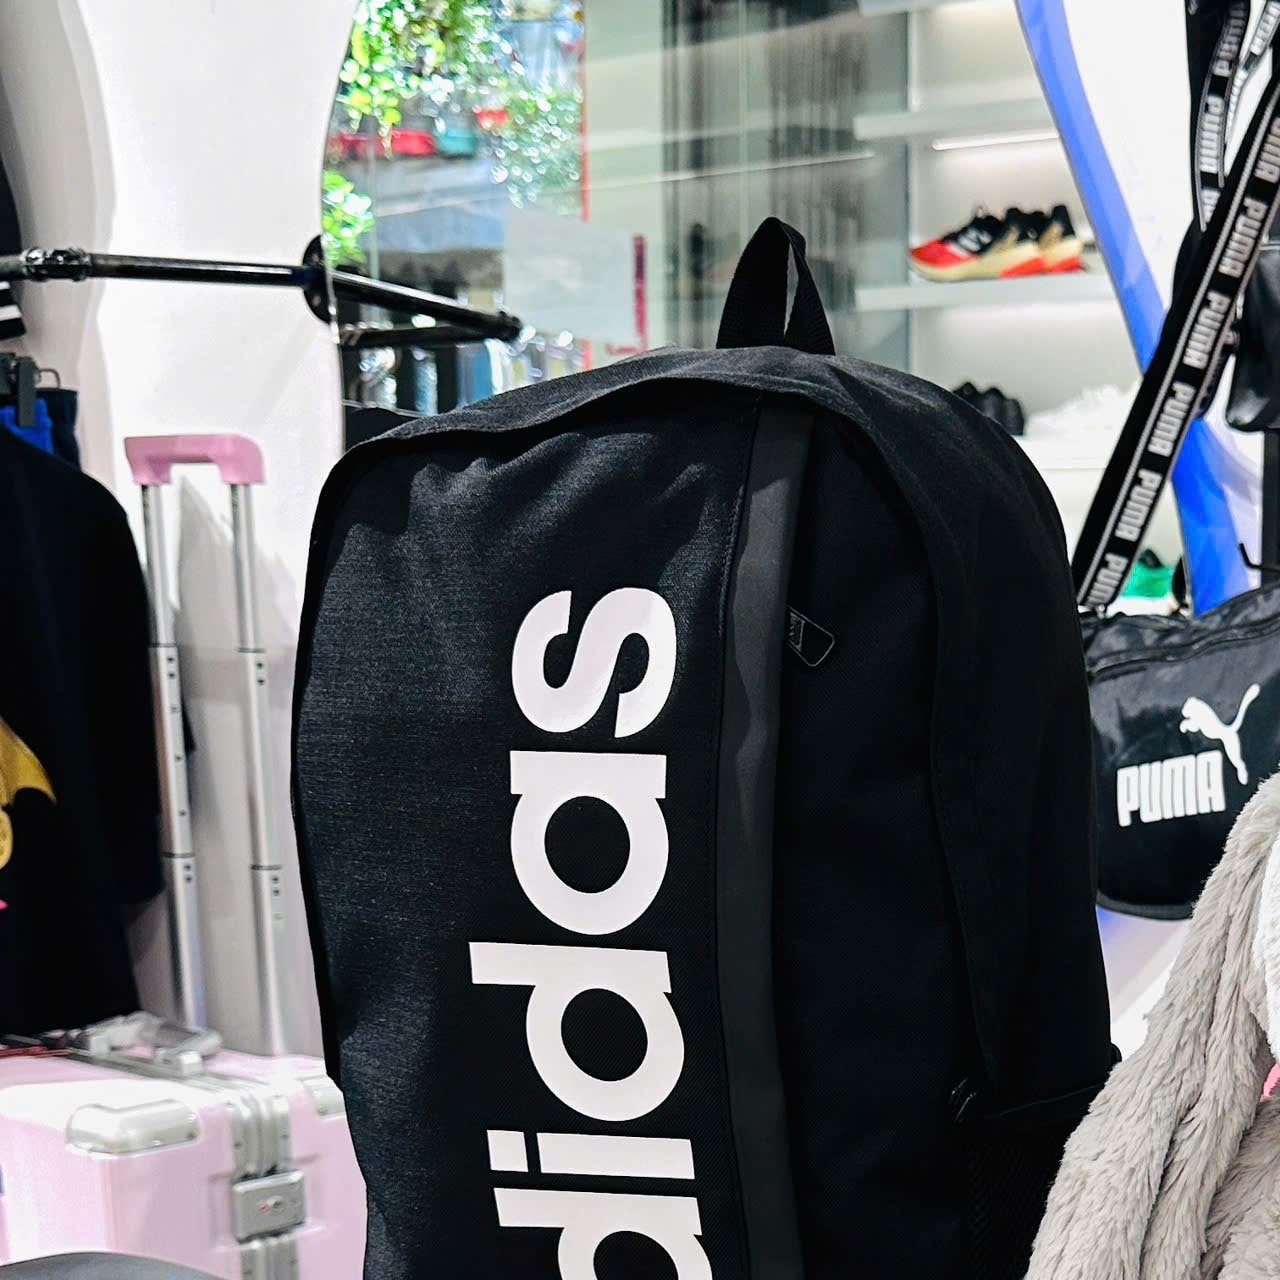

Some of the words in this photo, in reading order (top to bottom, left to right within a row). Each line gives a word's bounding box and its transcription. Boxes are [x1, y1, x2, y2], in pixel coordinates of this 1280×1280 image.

[1200, 94, 1225, 174] PUMA
[1216, 196, 1269, 278] PUMA
[1182, 289, 1231, 370] PUMA
[1147, 380, 1196, 457] PUMA
[1114, 468, 1164, 542] PUMA
[1084, 552, 1129, 608] PUM
[1116, 749, 1226, 828] PUMA
